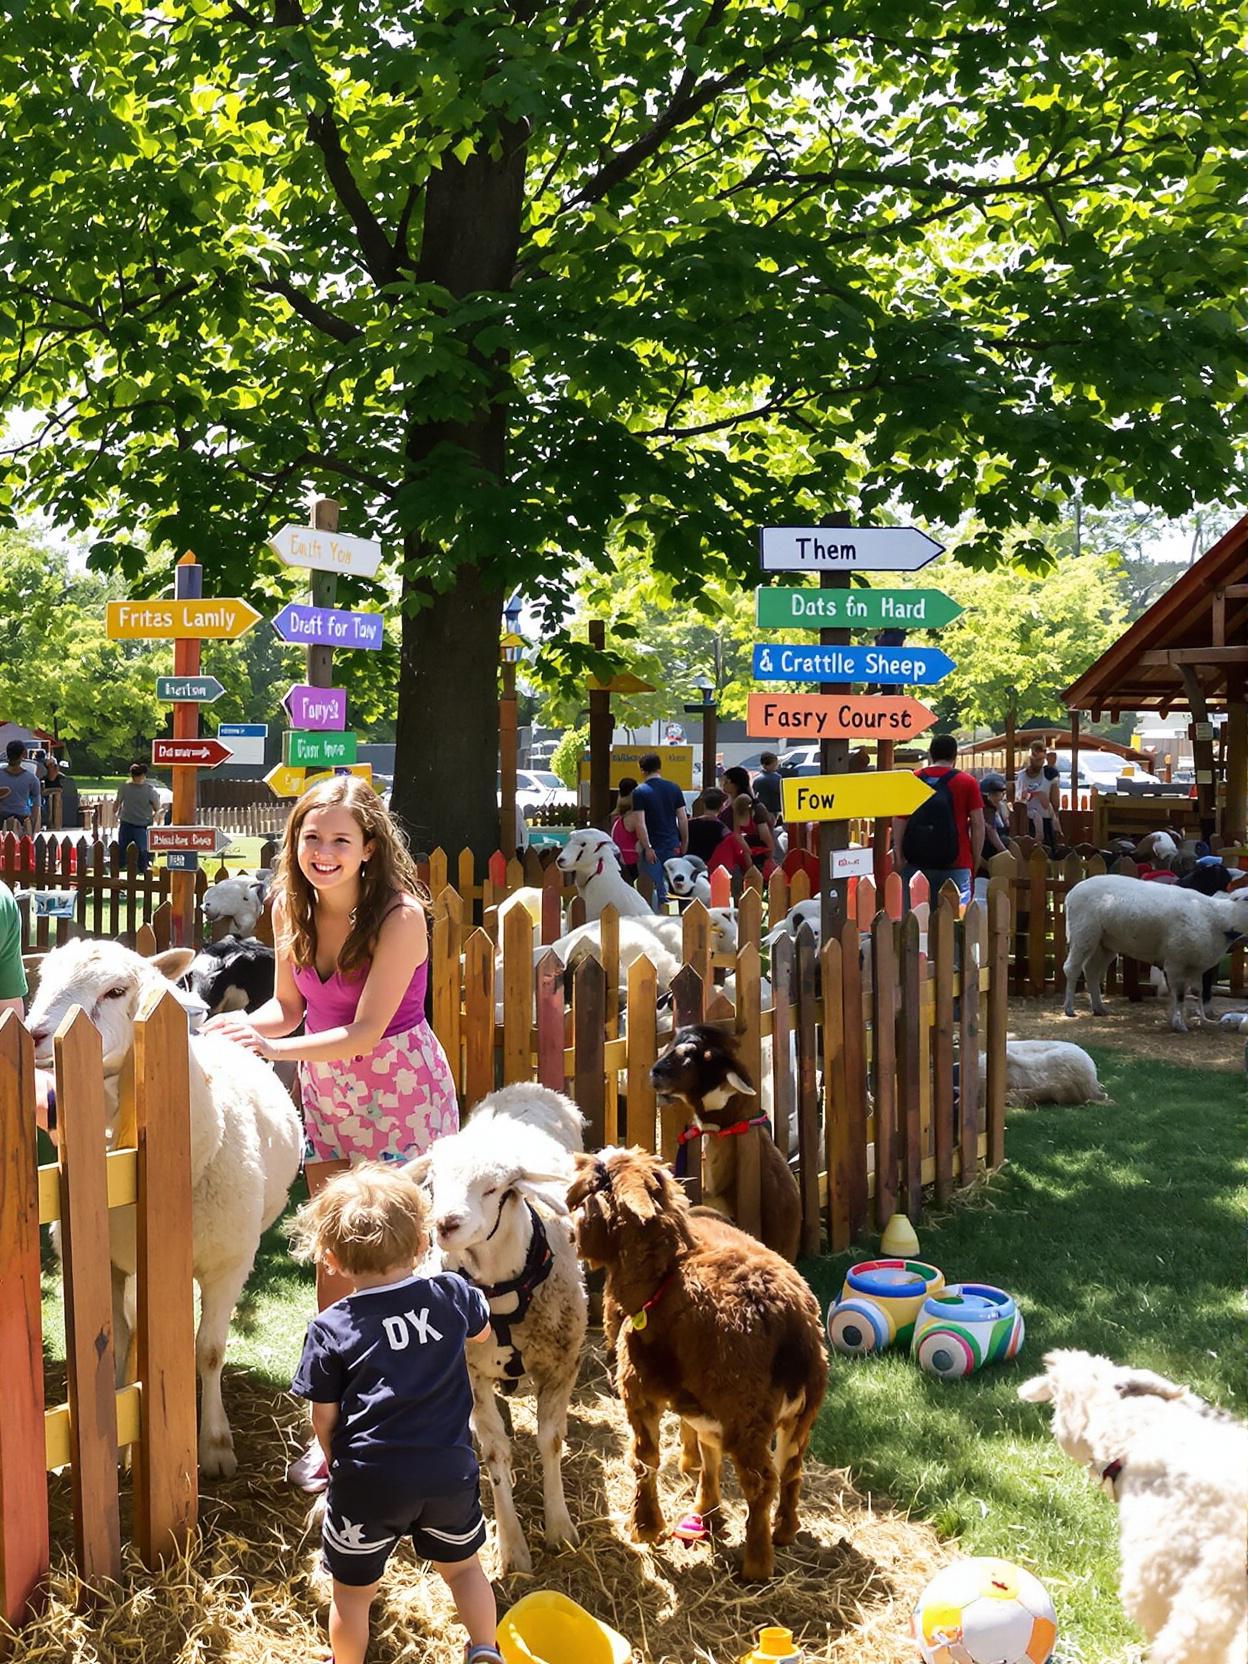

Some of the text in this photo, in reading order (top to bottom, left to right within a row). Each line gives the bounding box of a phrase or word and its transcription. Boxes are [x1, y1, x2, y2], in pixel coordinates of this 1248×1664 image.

[795, 537, 857, 560] Them
[881, 598, 926, 619] Hard
[328, 615, 348, 637] for
[865, 653, 927, 681] Sheep
[764, 703, 828, 733] Fasry
[797, 788, 835, 810] Fow
